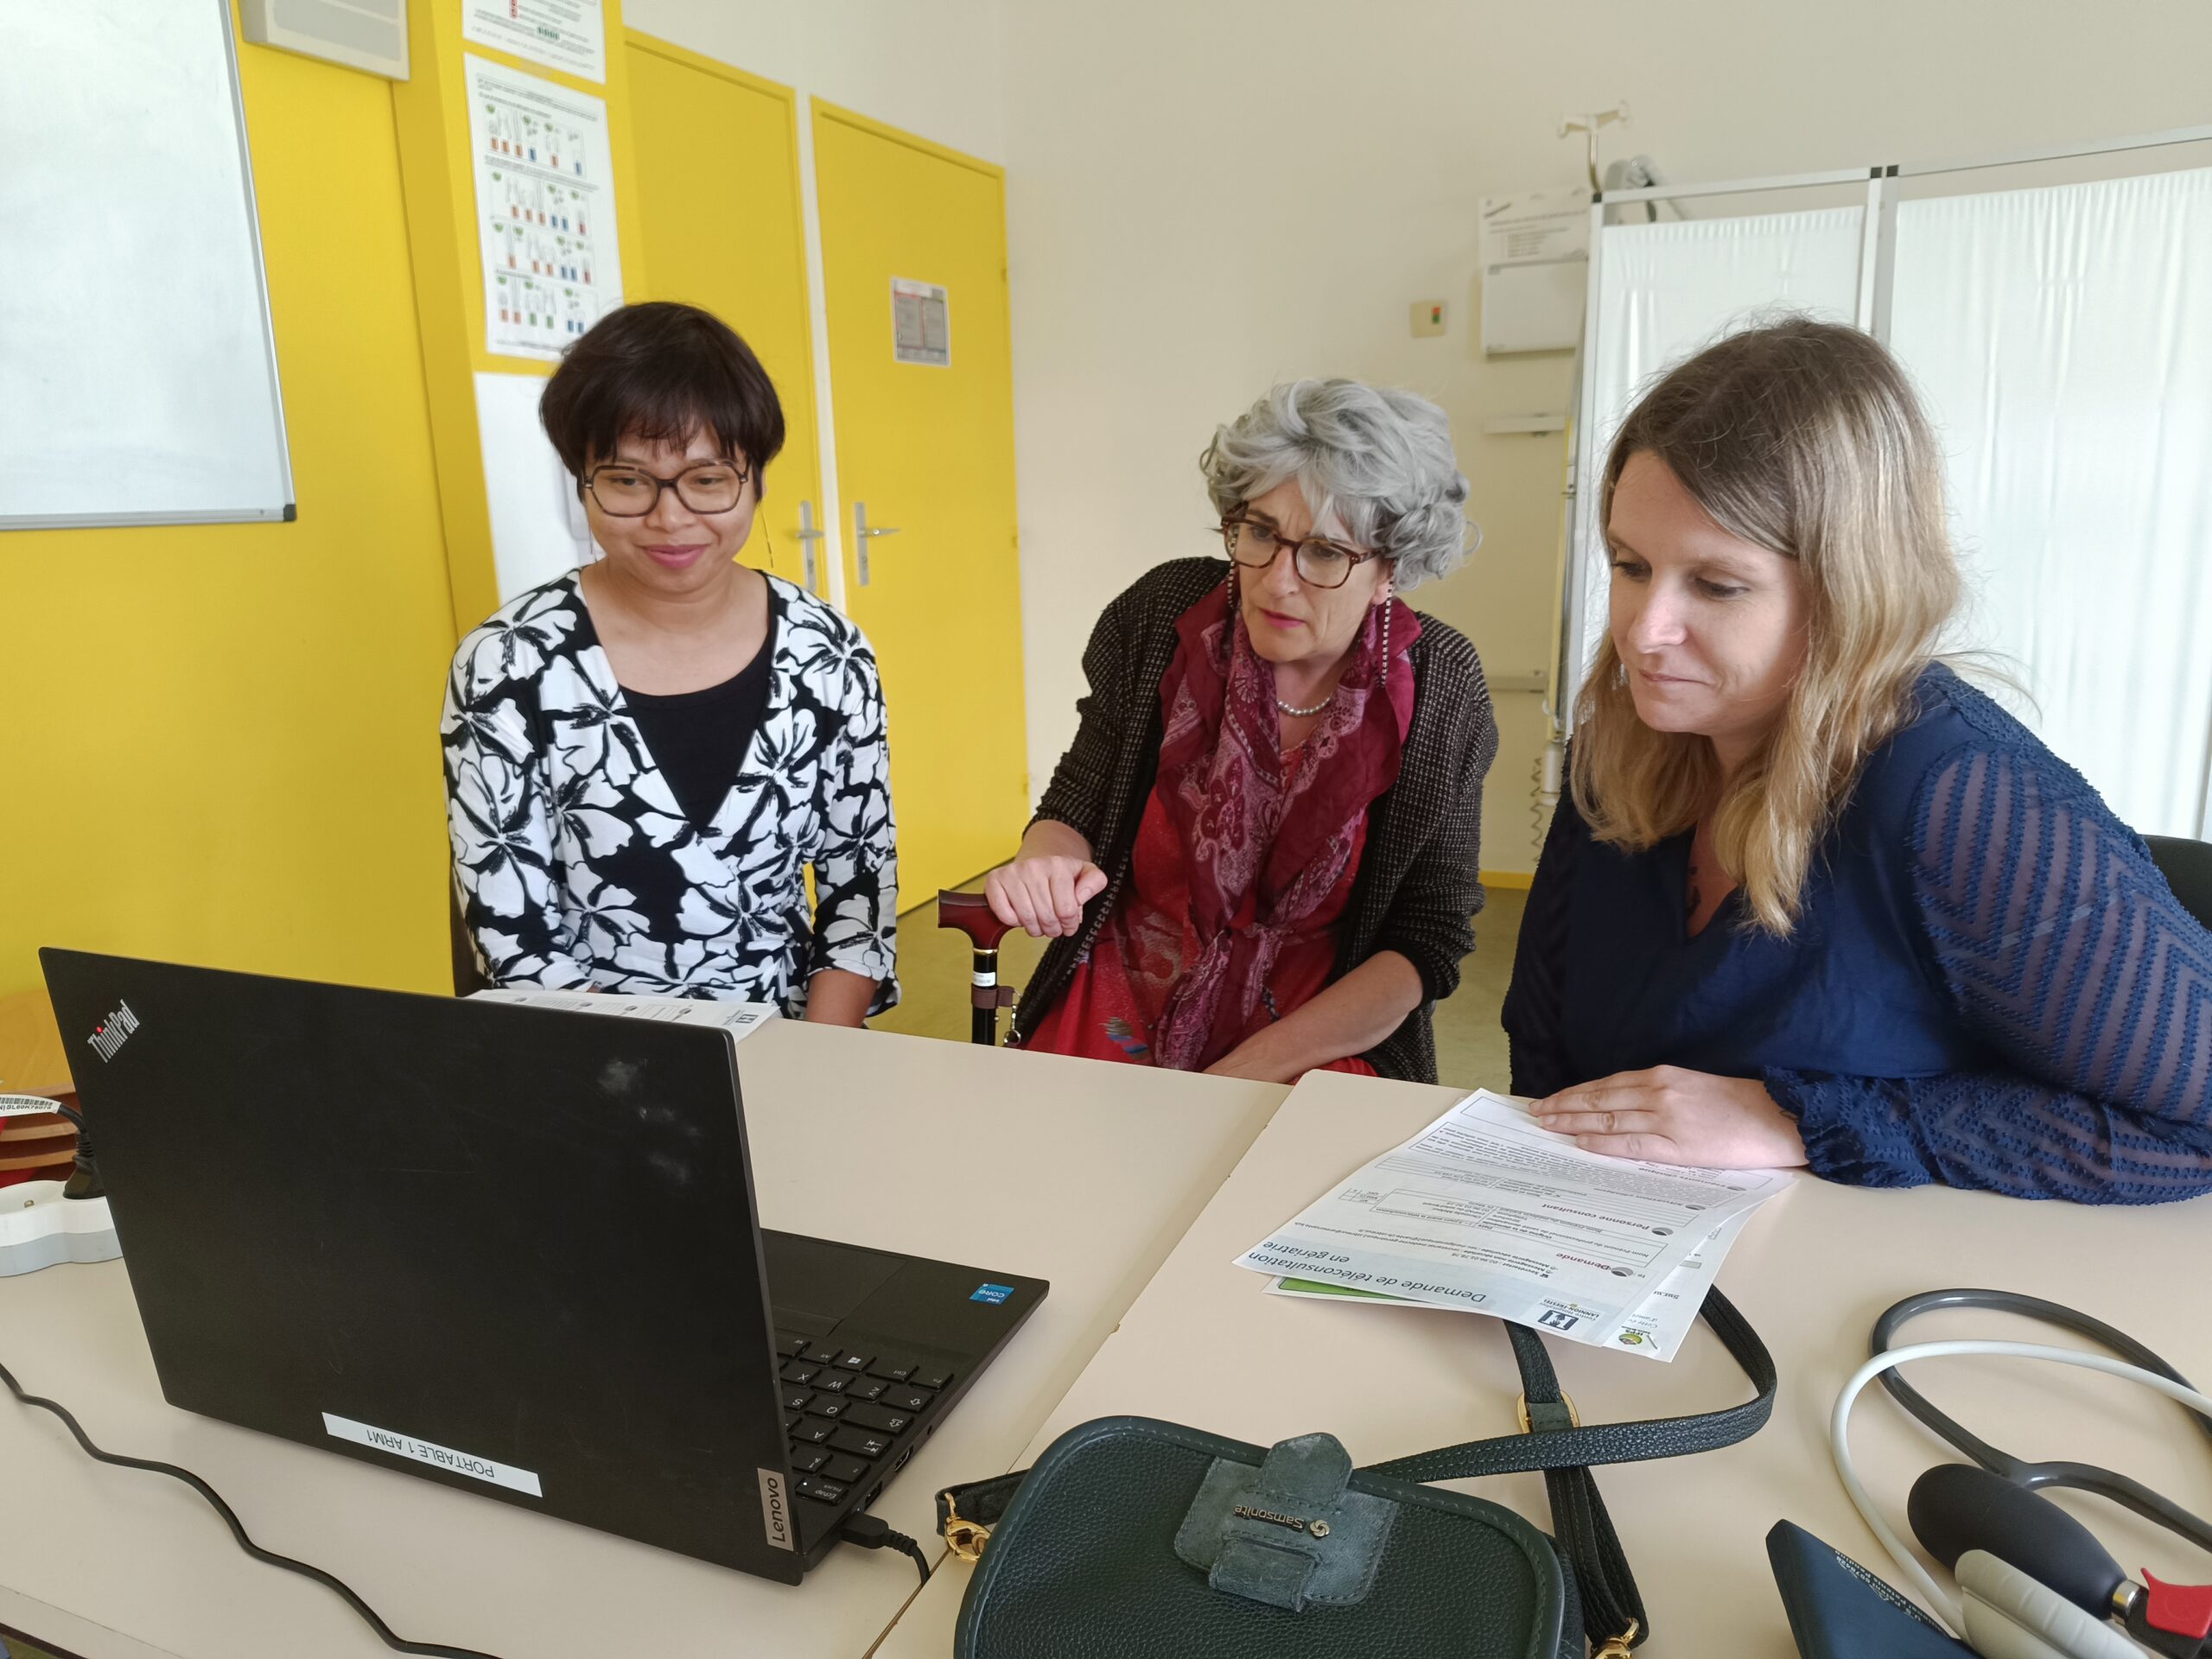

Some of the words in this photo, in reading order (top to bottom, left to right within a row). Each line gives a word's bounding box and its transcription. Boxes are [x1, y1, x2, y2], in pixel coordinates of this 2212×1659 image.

[87, 999, 140, 1063] ThinkPad
[1541, 1203, 1597, 1222] consultant
[1599, 1215, 1650, 1230] Personne
[1263, 1241, 1329, 1262] gériatrie
[1330, 1255, 1350, 1265] en
[1555, 1253, 1609, 1270] Demande
[1248, 1251, 1372, 1284] téléconsultation
[1376, 1277, 1398, 1290] de
[1402, 1280, 1486, 1303] Demande
[826, 1405, 838, 1414] Q
[366, 1429, 402, 1450] ARM1
[408, 1441, 415, 1453] 1
[417, 1445, 494, 1478] PORTABLE
[767, 1478, 786, 1542] Lenovo
[1234, 1505, 1305, 1529] Samsonite
